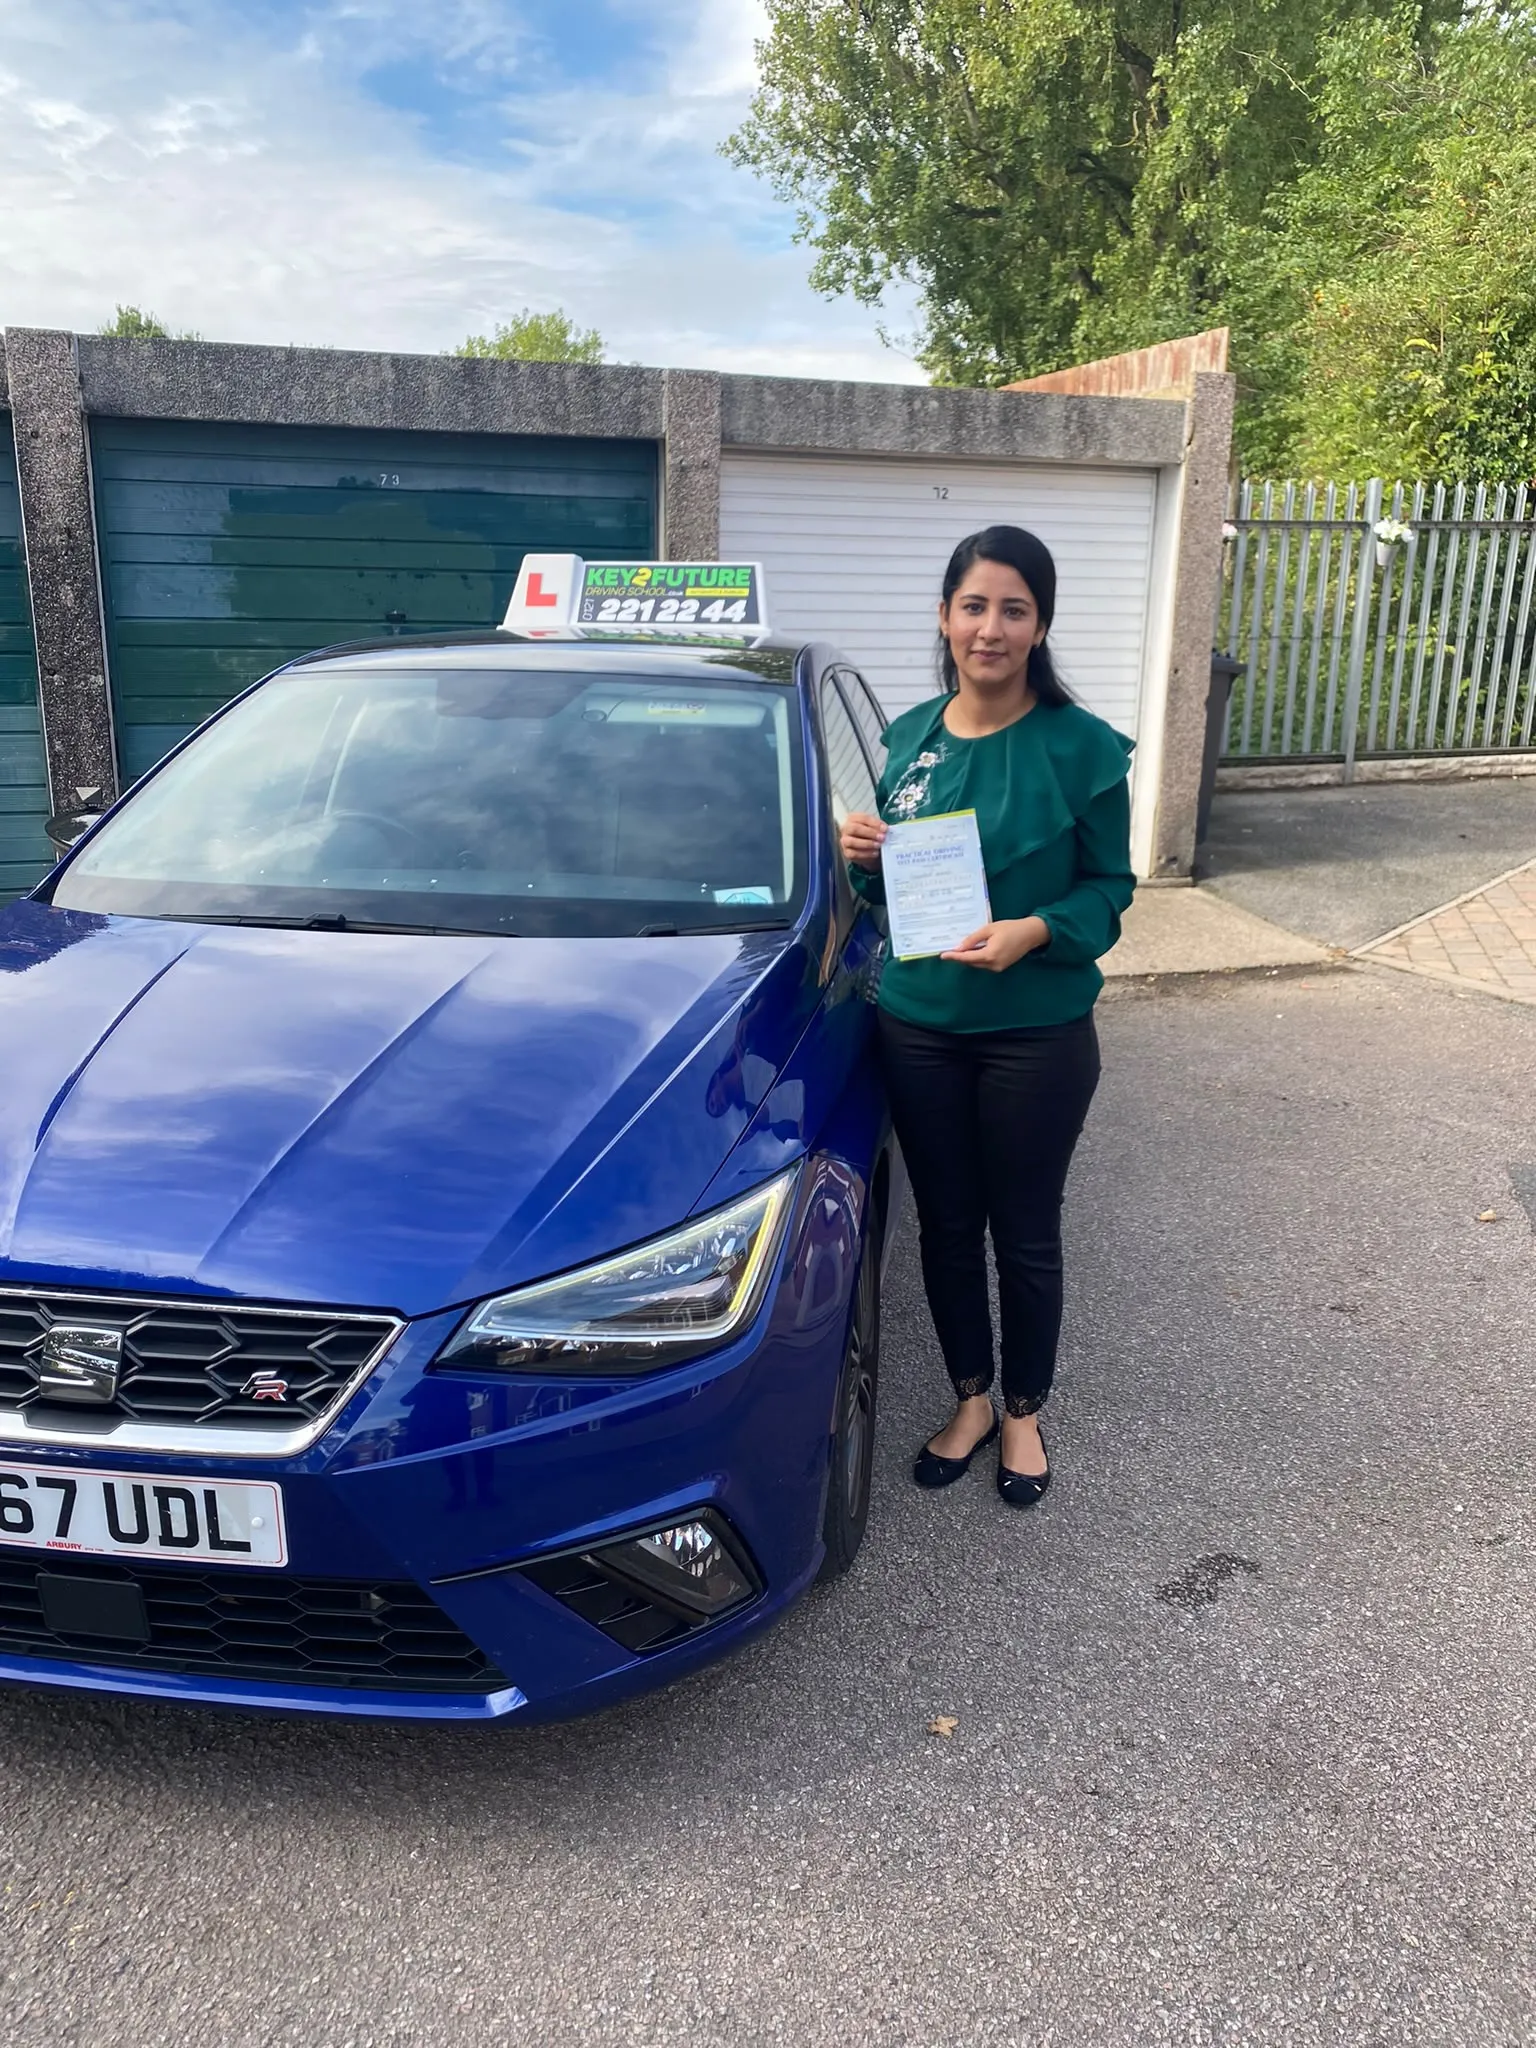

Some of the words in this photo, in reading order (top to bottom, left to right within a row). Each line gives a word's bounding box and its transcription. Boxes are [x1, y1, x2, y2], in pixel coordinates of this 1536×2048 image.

[379, 473, 400, 487] 73
[932, 486, 949, 500] 72
[586, 567, 751, 587] KEY2FUTURE
[525, 573, 557, 607] L
[585, 586, 626, 596] DRIVING
[582, 598, 595, 621] 0121
[596, 598, 656, 622] 221
[656, 598, 700, 622] 22
[701, 599, 747, 622] 44
[102, 1481, 252, 1553] UDL
